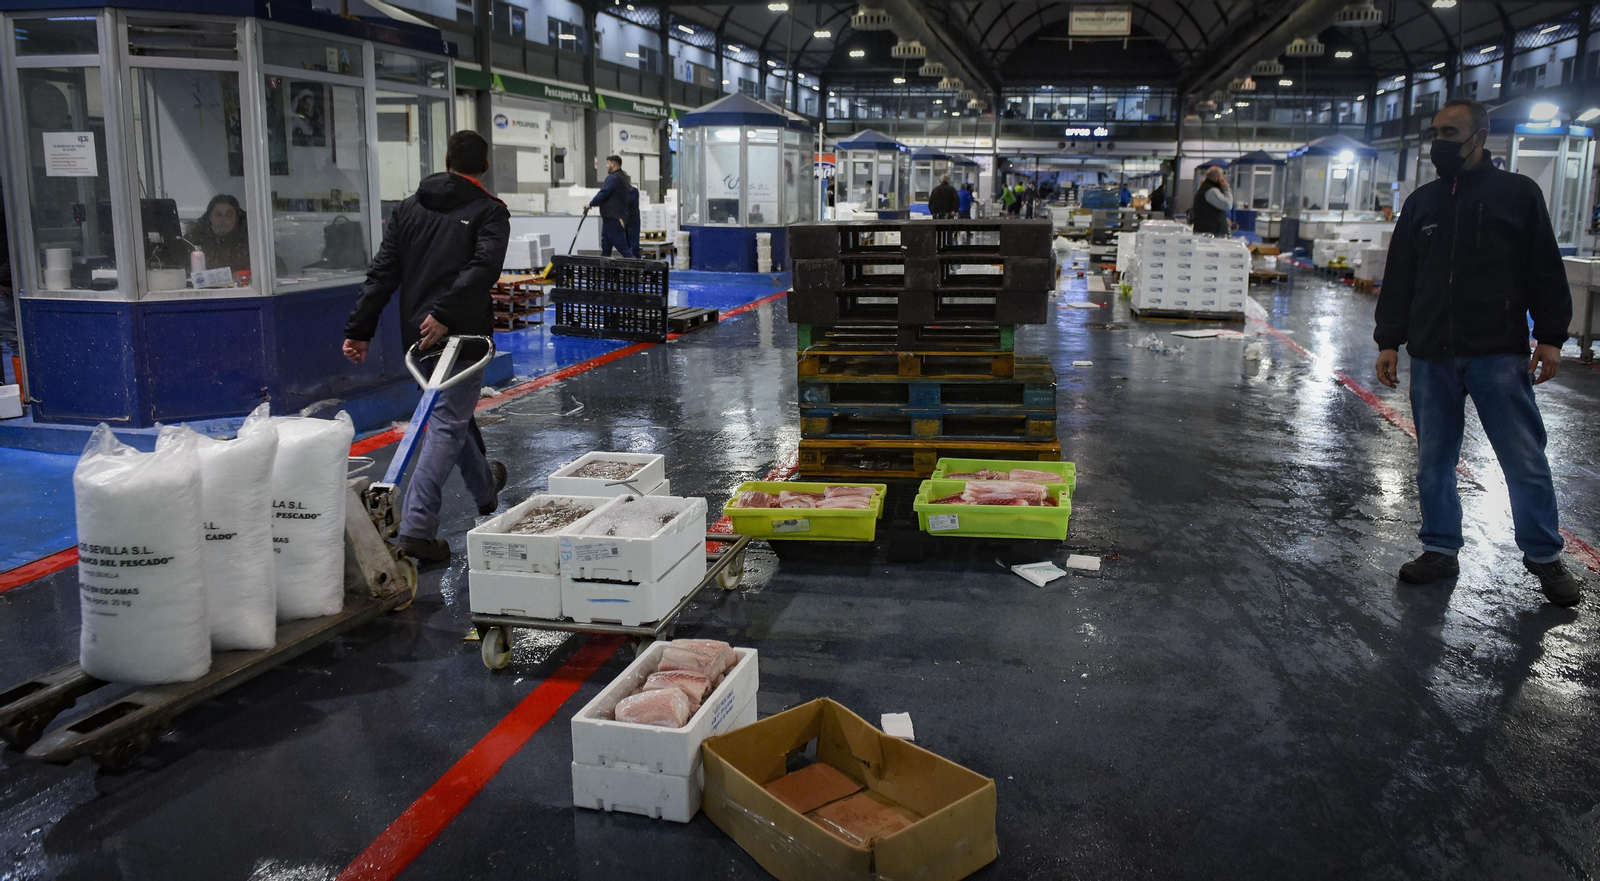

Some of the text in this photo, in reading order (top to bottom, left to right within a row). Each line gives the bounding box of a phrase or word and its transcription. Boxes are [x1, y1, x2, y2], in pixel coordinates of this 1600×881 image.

[266, 2, 272, 18] 1
[442, 41, 449, 54] 3
[288, 501, 307, 510] S.L.
[88, 544, 128, 555] SEVILLA
[131, 546, 155, 555] S.L.
[100, 559, 117, 567] DEL
[99, 587, 139, 595] ESCAMAS
